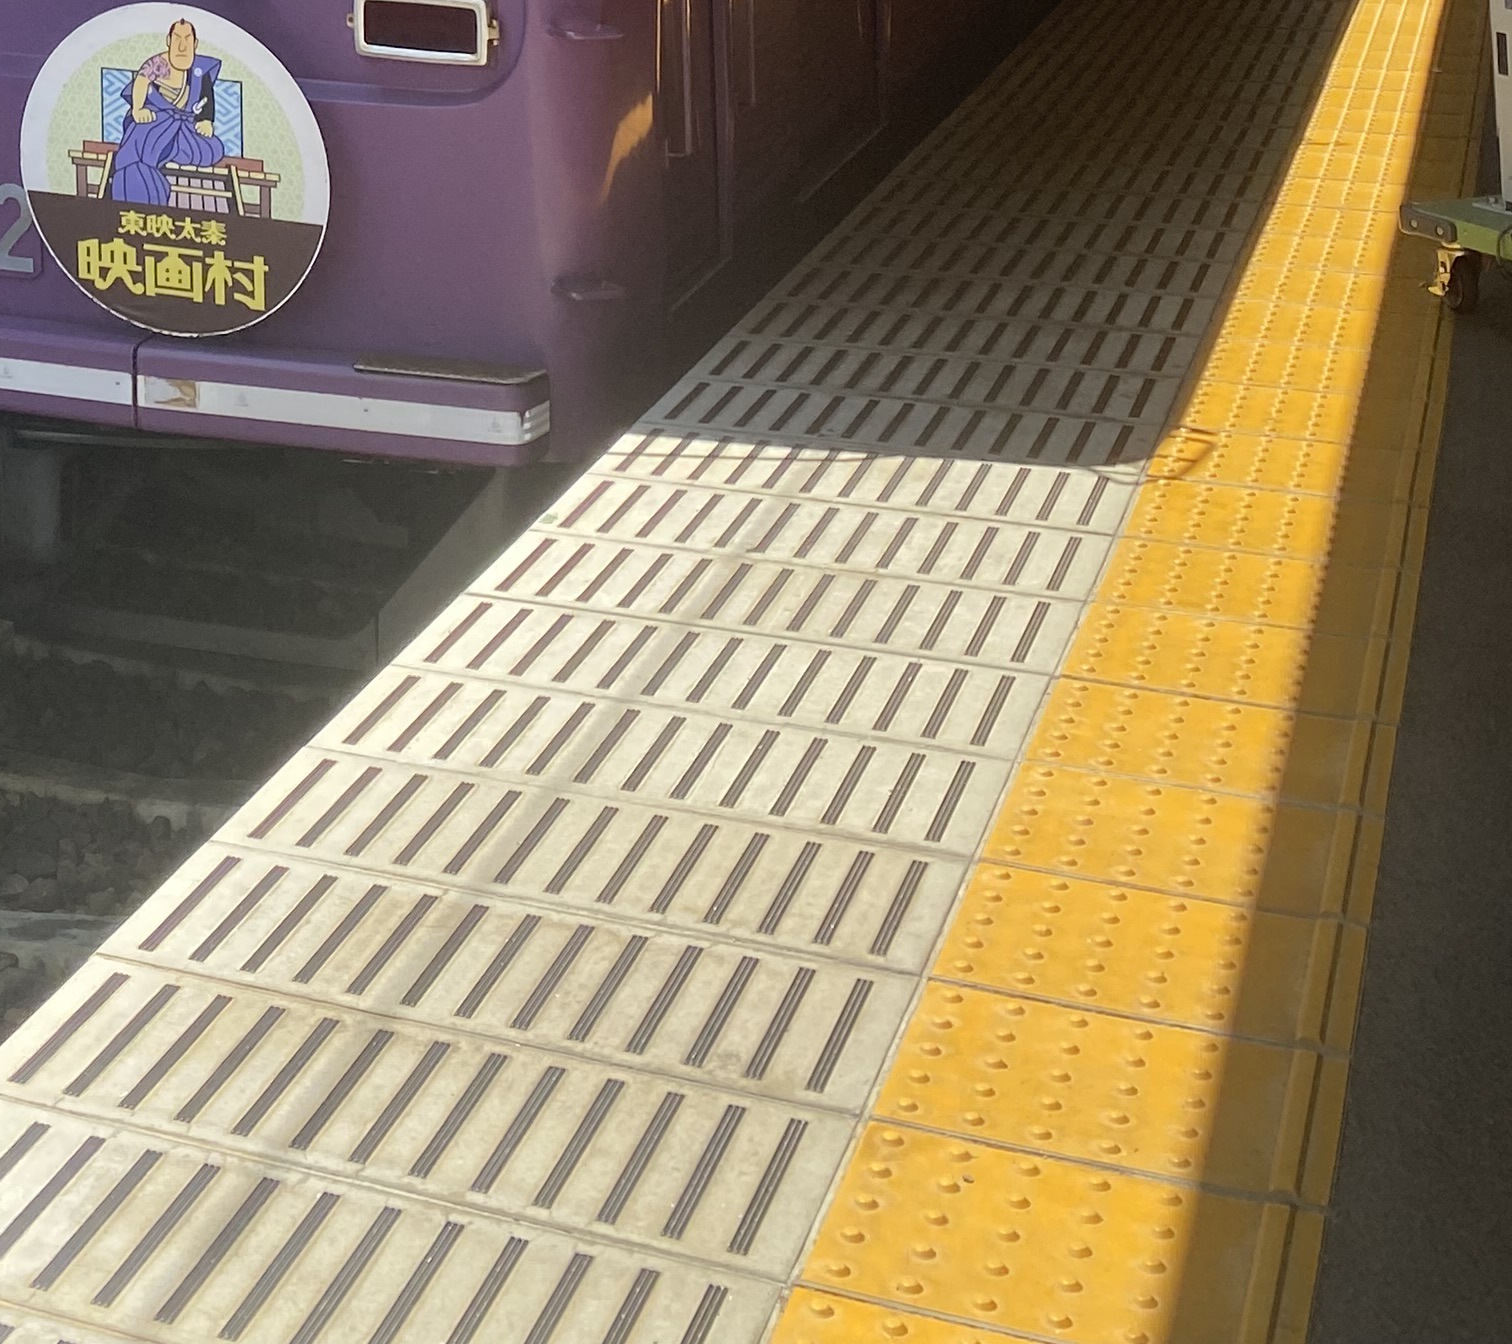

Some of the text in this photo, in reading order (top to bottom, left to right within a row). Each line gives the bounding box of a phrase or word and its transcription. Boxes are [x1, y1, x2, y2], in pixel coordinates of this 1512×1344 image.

[117, 210, 228, 246] 東映太秦
[77, 237, 270, 311] 映画村
